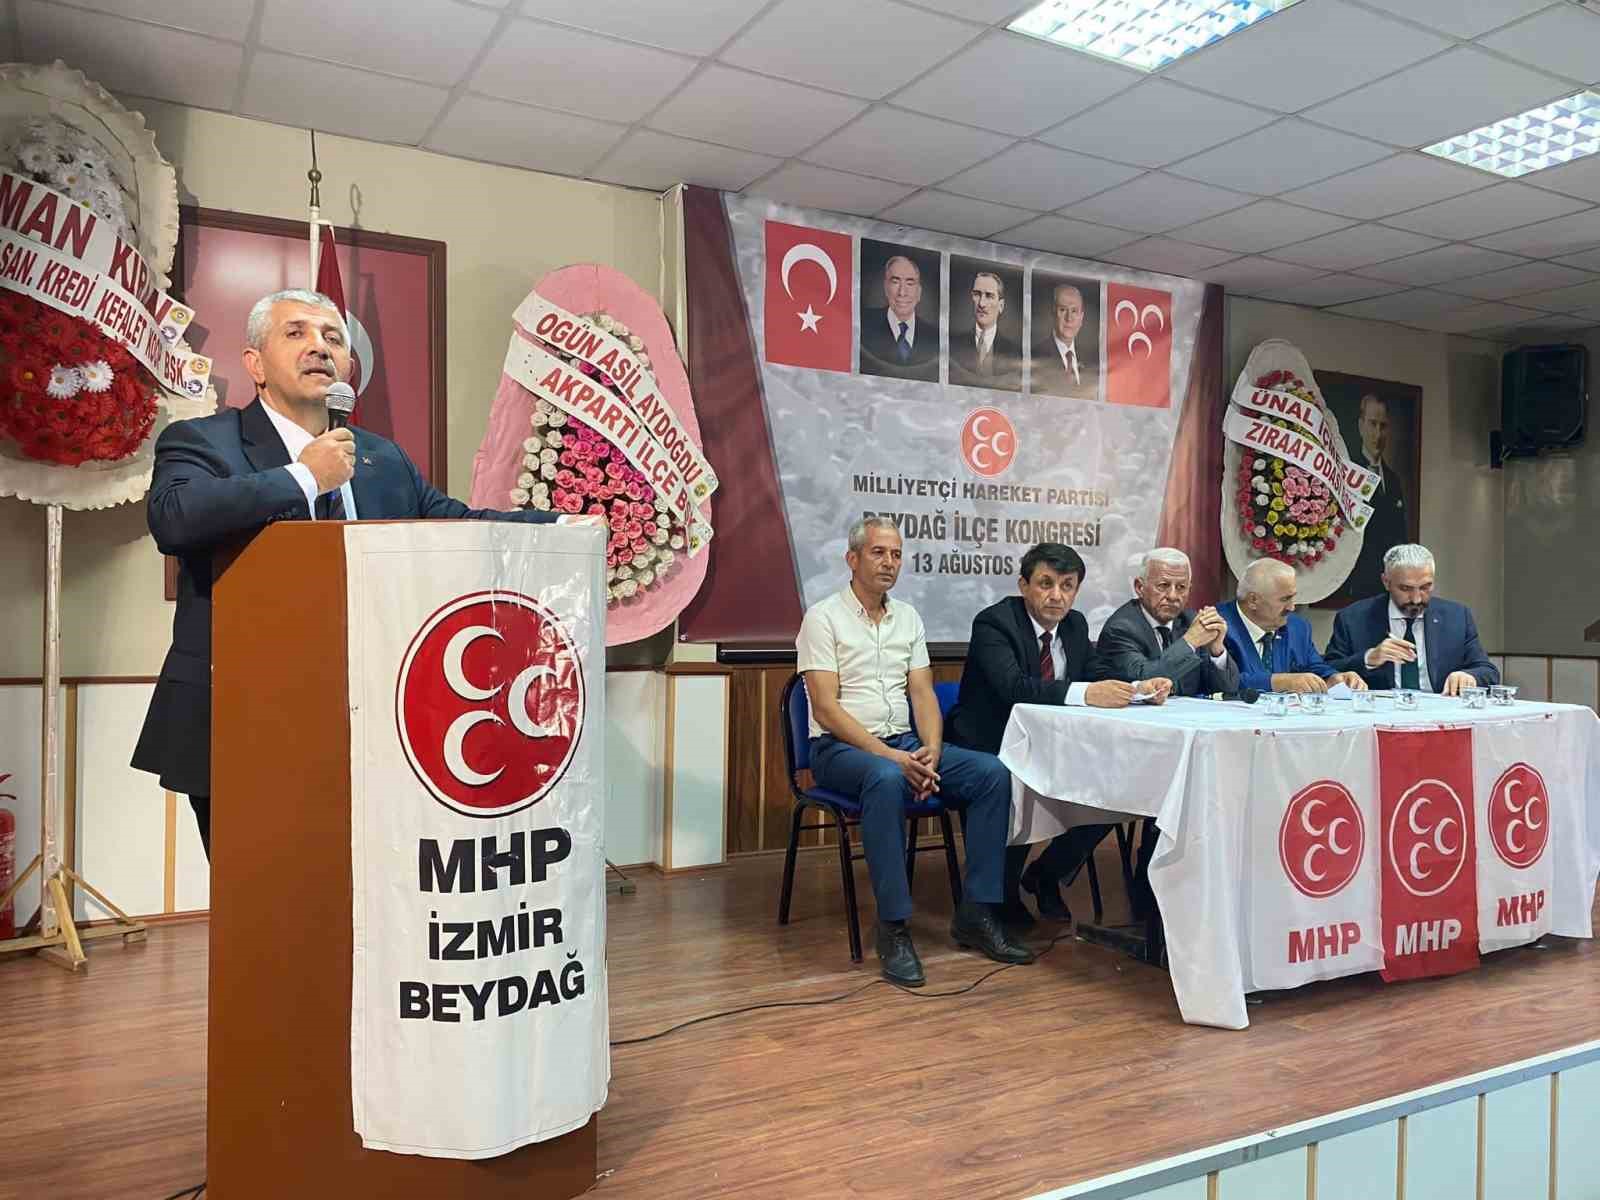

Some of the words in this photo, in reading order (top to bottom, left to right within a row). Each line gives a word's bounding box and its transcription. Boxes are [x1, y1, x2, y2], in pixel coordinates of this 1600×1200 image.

[0, 173, 97, 260] MAN
[36, 259, 99, 311] KREDİ
[94, 289, 147, 348] KEFALET
[536, 313, 604, 358] OGÜN
[597, 349, 642, 399] ASİL
[636, 394, 703, 485] AYDOĞDU
[1251, 390, 1313, 427] ÜNAL
[540, 368, 641, 448] AKPARTİ
[636, 437, 678, 496] İLÇE
[853, 471, 957, 502] MİLLİYETÇİ
[963, 483, 1042, 503] HAREKET
[863, 508, 946, 540] YDAĞ
[953, 510, 998, 548] İLÇE
[1005, 518, 1101, 546] KONGRESİ
[912, 552, 933, 573] 13
[938, 548, 1013, 575] AĞUSTOS
[418, 827, 572, 894] MHP
[428, 902, 563, 960] İZMİR
[1496, 889, 1545, 926] MHP
[1288, 922, 1361, 963] MHP
[1395, 919, 1462, 956] MHP
[399, 950, 585, 1022] BEYDAĞ
